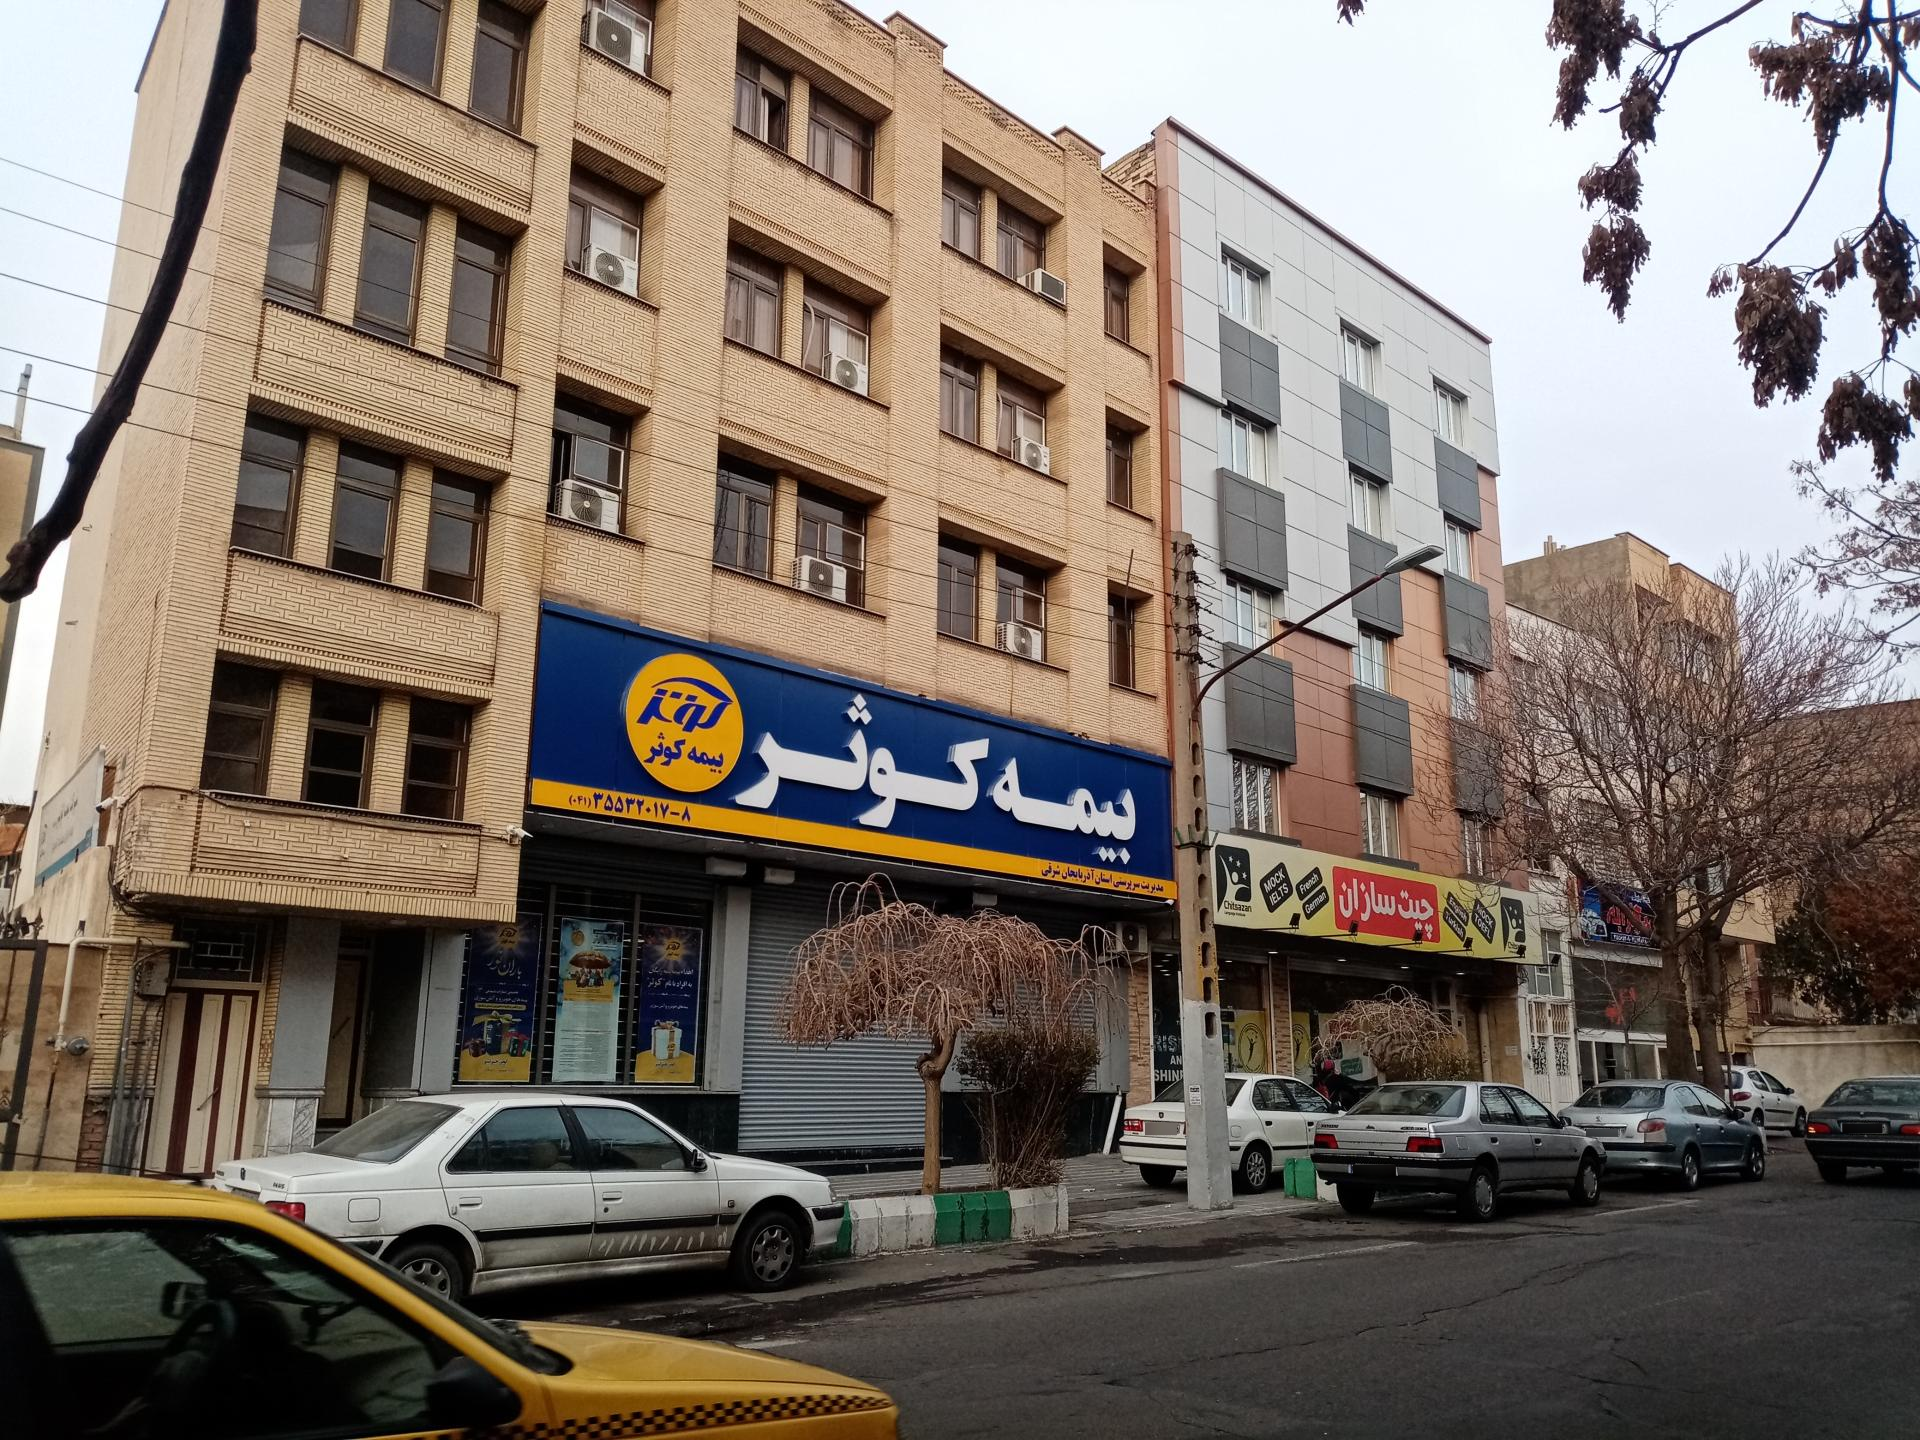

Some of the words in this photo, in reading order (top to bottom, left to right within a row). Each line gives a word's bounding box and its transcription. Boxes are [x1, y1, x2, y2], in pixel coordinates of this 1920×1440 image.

[644, 732, 686, 766] کوثر
[687, 746, 724, 774] بیمه
[733, 694, 989, 828] کوثر
[989, 757, 1135, 864] بیمه
[1042, 863, 1061, 878] شرقی
[1062, 866, 1094, 883] آذربایجان
[1095, 872, 1113, 884] استان
[1263, 868, 1286, 893] MOCK
[1113, 877, 1141, 890] سرپرستی
[1141, 881, 1164, 894] مدیریت
[1268, 883, 1289, 906] IELTS
[1299, 873, 1320, 894] French
[1224, 900, 1252, 912] Chitsazan
[1304, 891, 1327, 914] German
[1339, 878, 1396, 922] سازان
[1445, 911, 1464, 936] Turkish
[1473, 913, 1491, 939] TOEFL
[1170, 1055, 1182, 1065] AN
